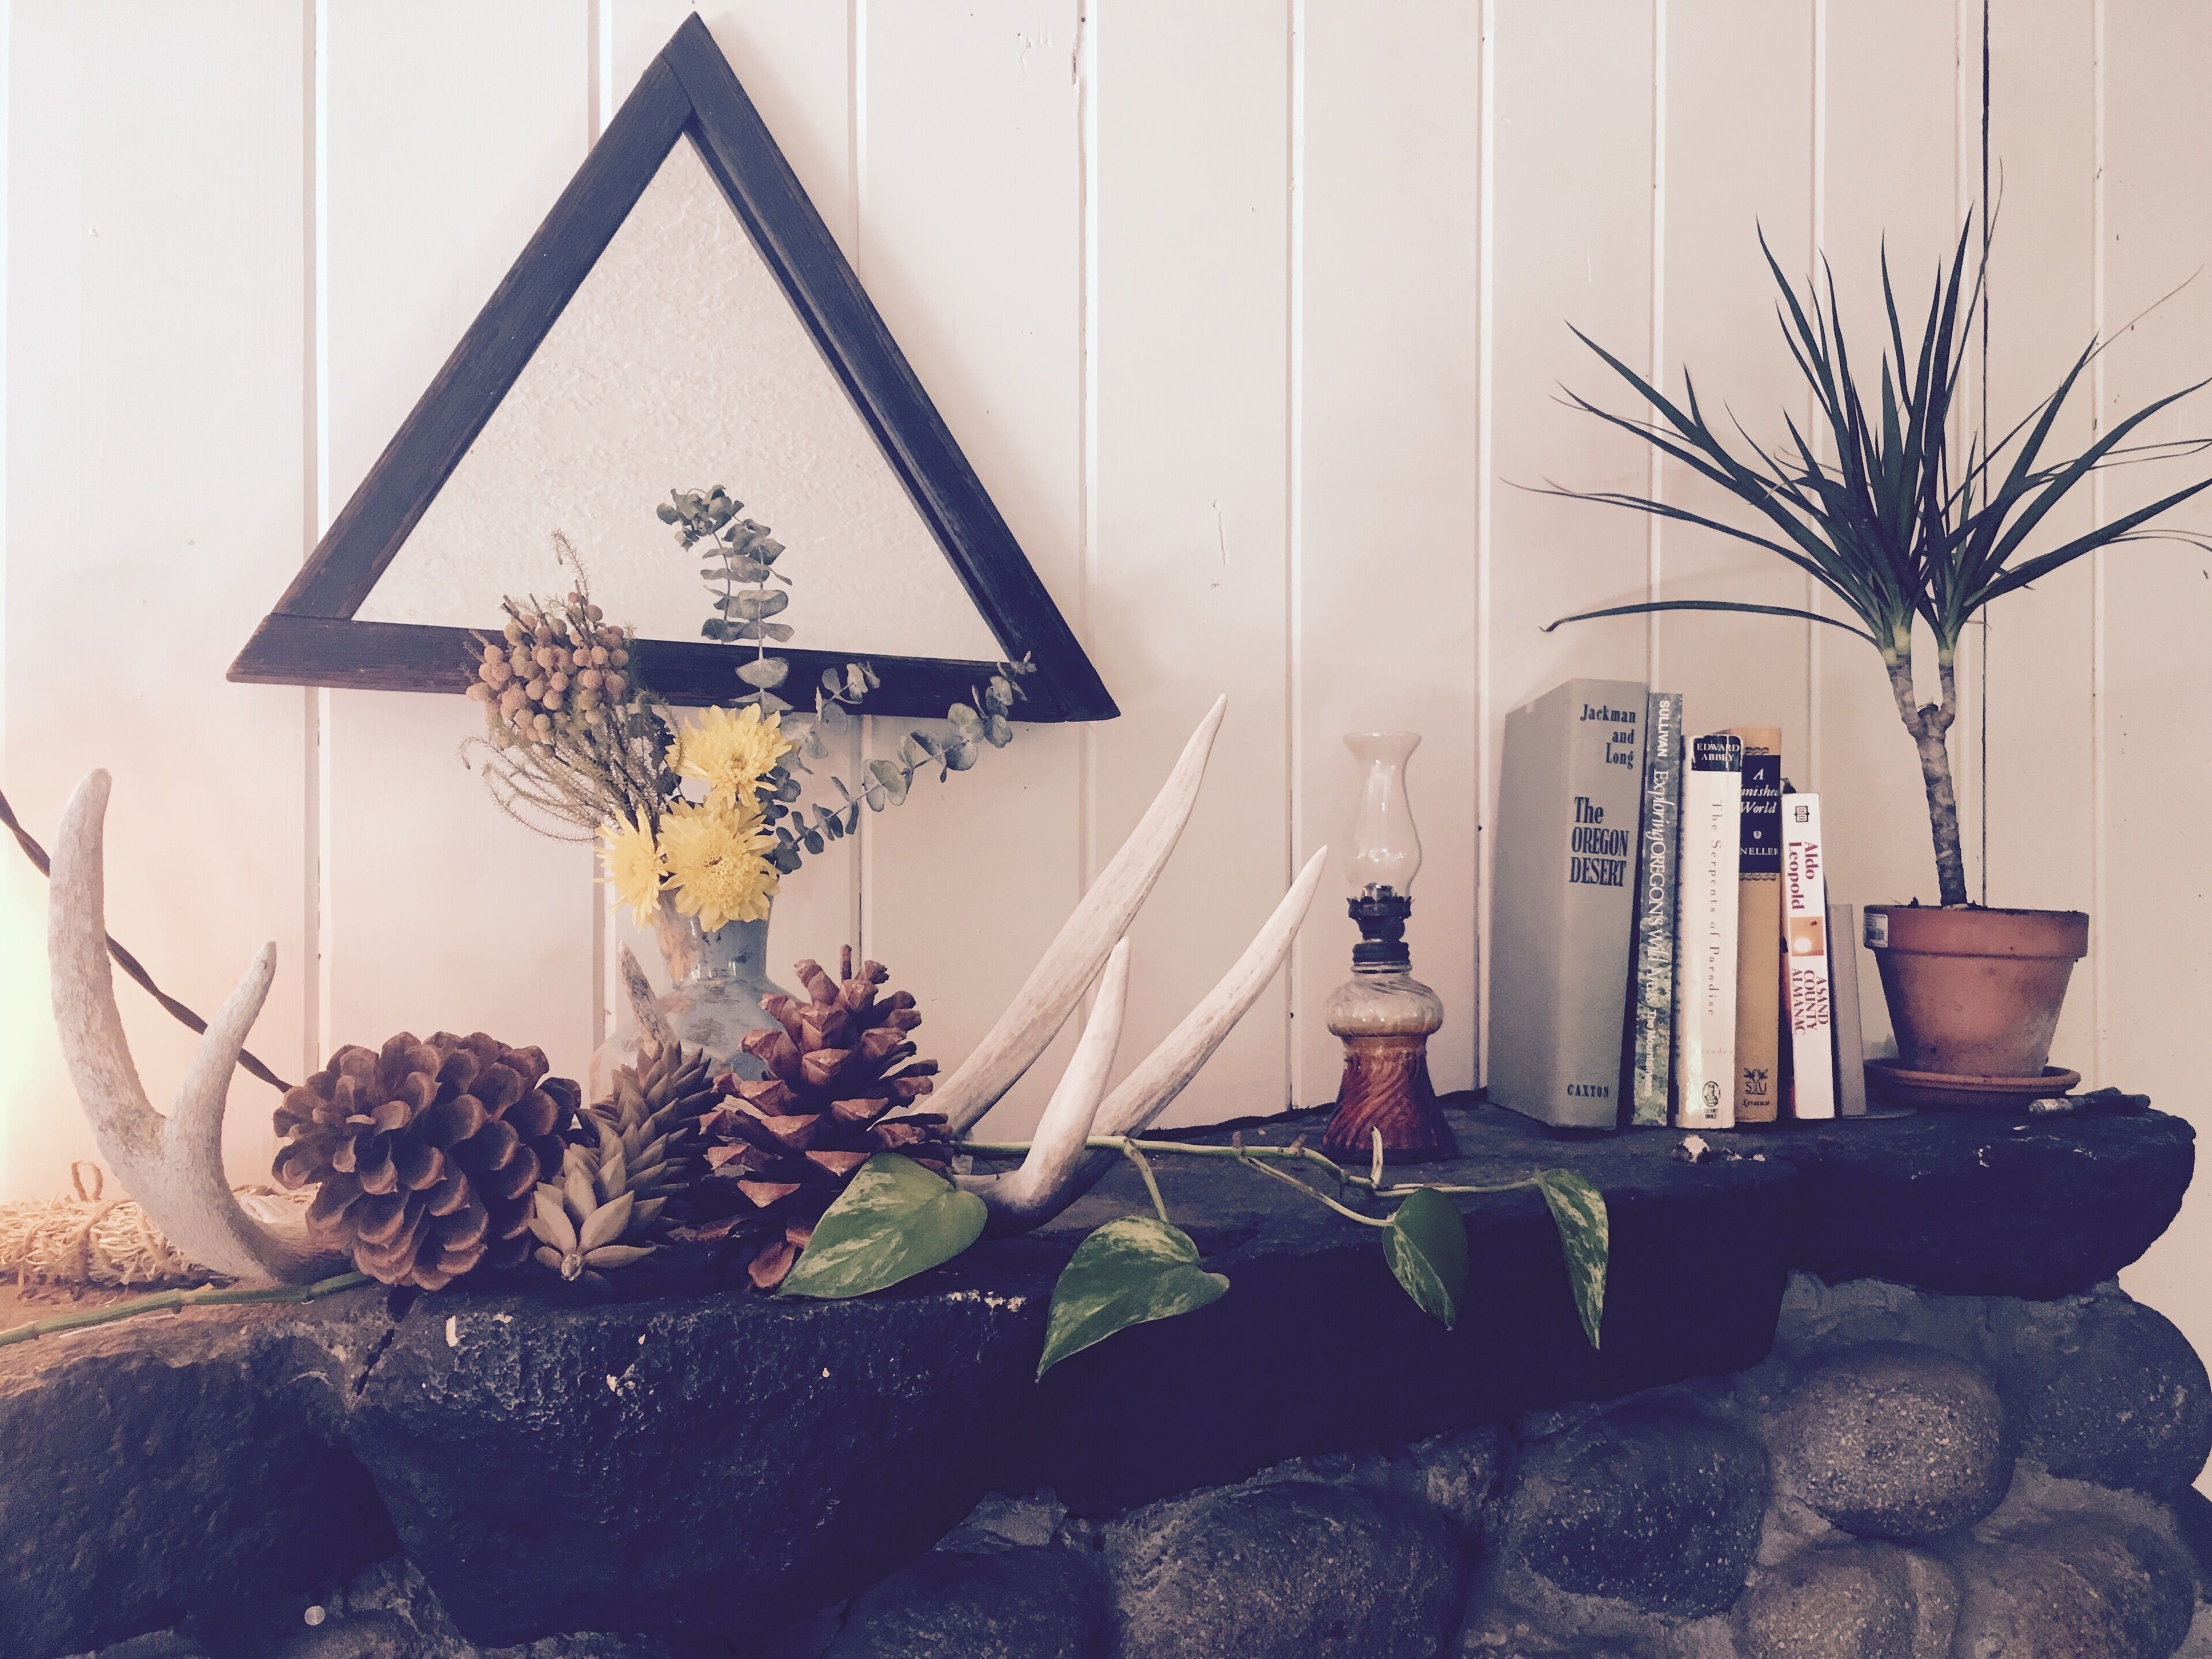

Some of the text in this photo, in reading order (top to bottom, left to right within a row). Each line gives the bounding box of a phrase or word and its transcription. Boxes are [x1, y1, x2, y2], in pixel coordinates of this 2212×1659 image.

[1580, 704, 1636, 724] Jackman
[1657, 699, 1671, 757] SULLIVAN
[1612, 729, 1635, 744] and
[1696, 743, 1740, 752] EDWARD
[1605, 742, 1634, 770] Long
[1753, 768, 1764, 780] A
[1574, 796, 1604, 824] The
[1645, 769, 1675, 841] Exploring
[1740, 801, 1777, 814] World
[1571, 826, 1630, 857] OREGON
[1569, 856, 1627, 887] DESERT
[1787, 842, 1805, 910] Leopold
[1804, 841, 1819, 880] Aldo
[1708, 800, 1724, 1016] The Serpents of Paradise
[1647, 928, 1669, 964] Wild
[1791, 968, 1806, 1036] ALMANAC
[1803, 969, 1817, 1031] COUNTY
[1646, 1009, 1657, 1029] The
[1567, 1084, 1609, 1098] CAXTON
